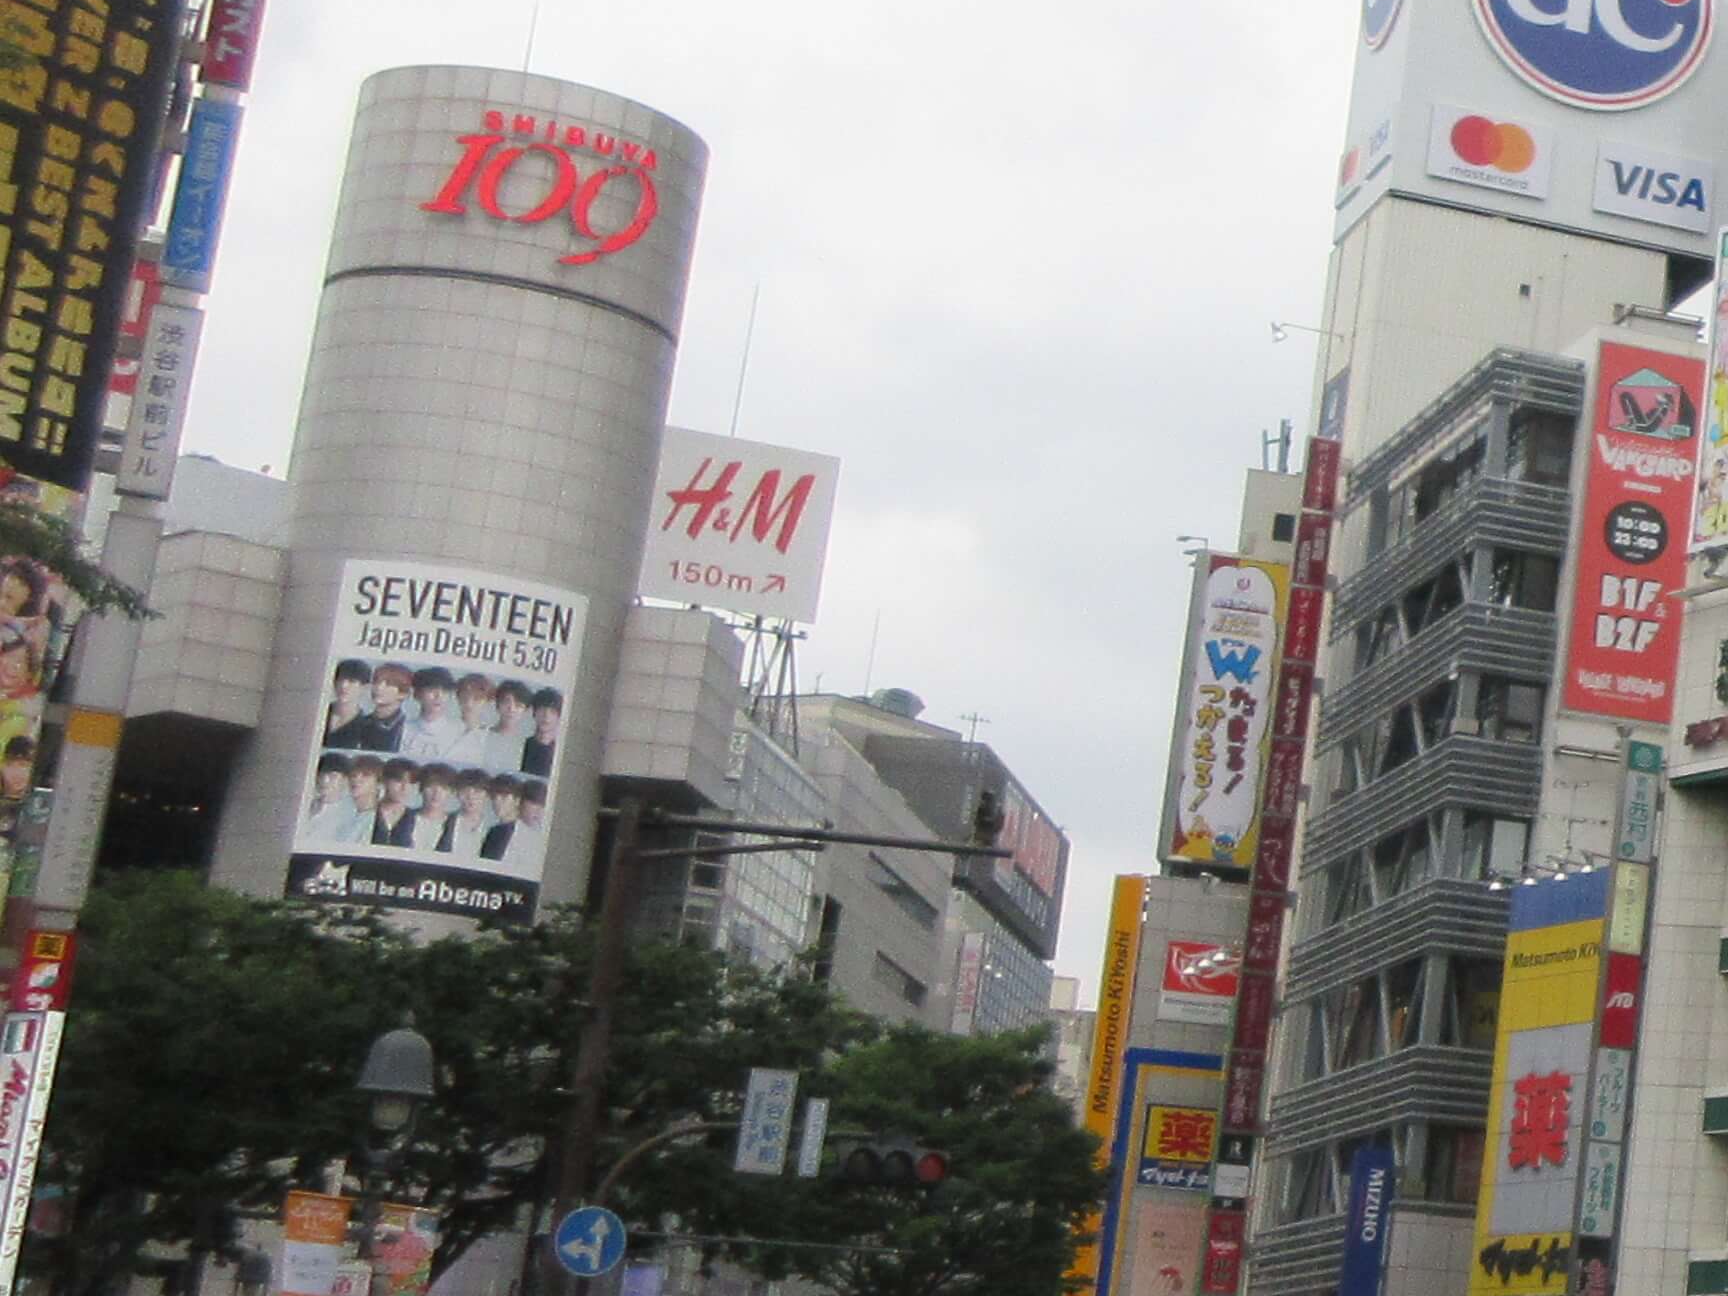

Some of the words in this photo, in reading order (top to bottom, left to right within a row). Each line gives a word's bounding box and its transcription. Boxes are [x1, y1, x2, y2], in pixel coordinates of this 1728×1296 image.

[482, 109, 659, 171] SHIBUYA
[22, 122, 83, 252] BEST
[418, 131, 661, 267] 109
[1448, 165, 1530, 190] mastercard
[1605, 158, 1708, 212] VISA
[660, 456, 818, 555] H&M
[668, 558, 754, 593] 150m
[1600, 574, 1662, 613] B1F
[352, 573, 574, 647] SEVENTEEN
[1595, 613, 1660, 653] B2F
[356, 621, 430, 655] Japan
[431, 624, 508, 665] Debut
[510, 638, 559, 675] 5.30
[417, 879, 502, 912] Abema
[1511, 948, 1577, 970] Matsumoto
[1092, 1000, 1124, 1115] Matsumoto
